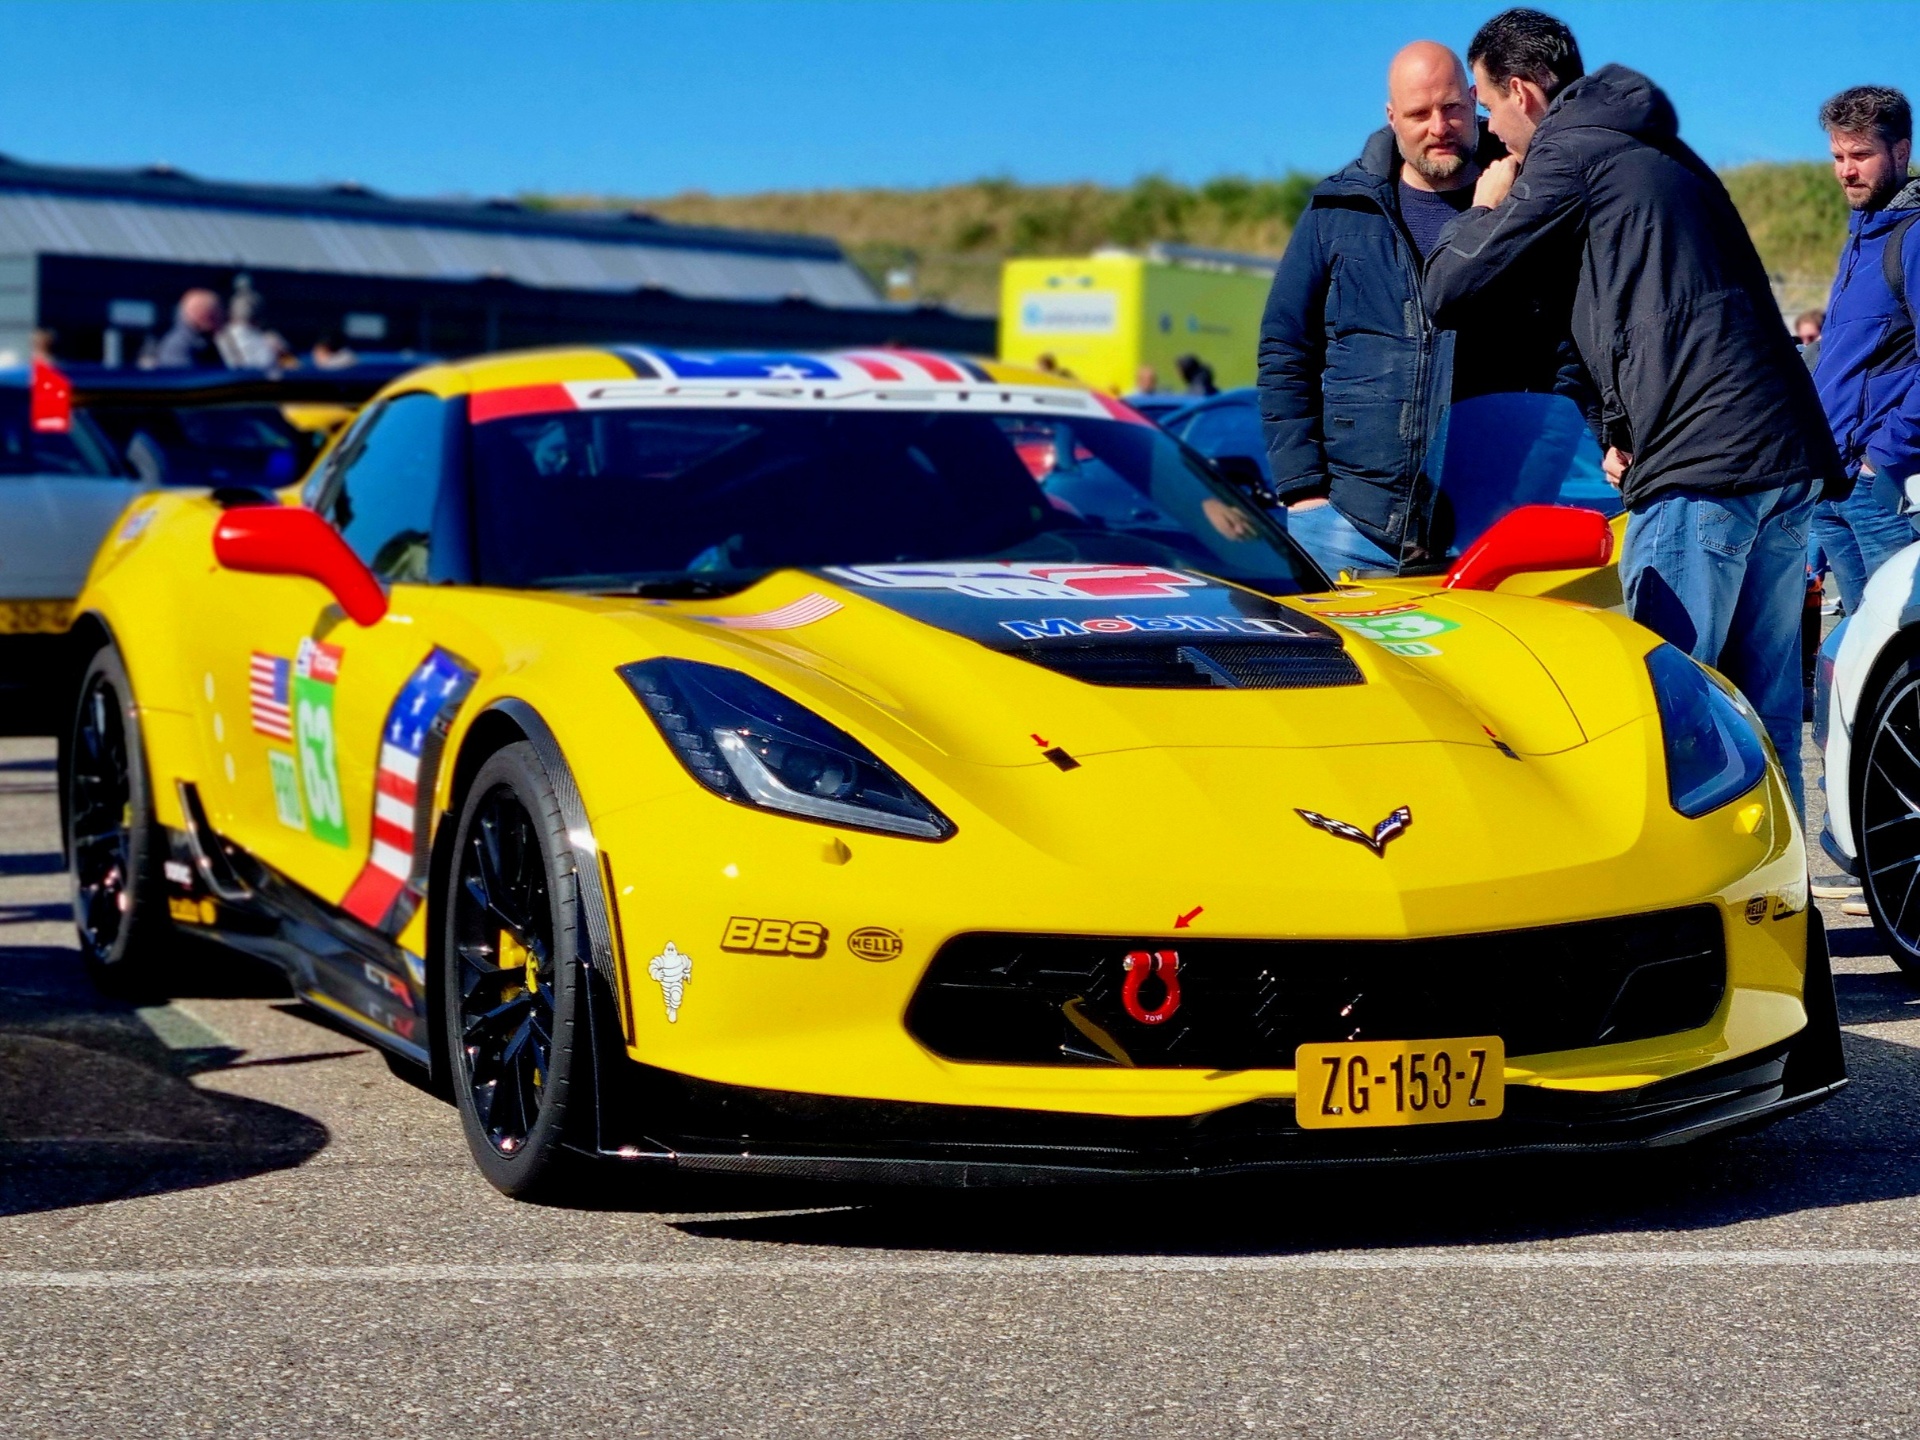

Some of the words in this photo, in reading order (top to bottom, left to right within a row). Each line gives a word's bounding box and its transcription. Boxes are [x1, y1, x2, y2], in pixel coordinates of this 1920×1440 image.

[588, 385, 1087, 408] CORVETTE
[999, 615, 1229, 640] Mobil
[720, 916, 829, 959] BBS
[1145, 1014, 1163, 1022] TOW
[1321, 1050, 1486, 1116] ZG-153-Z
